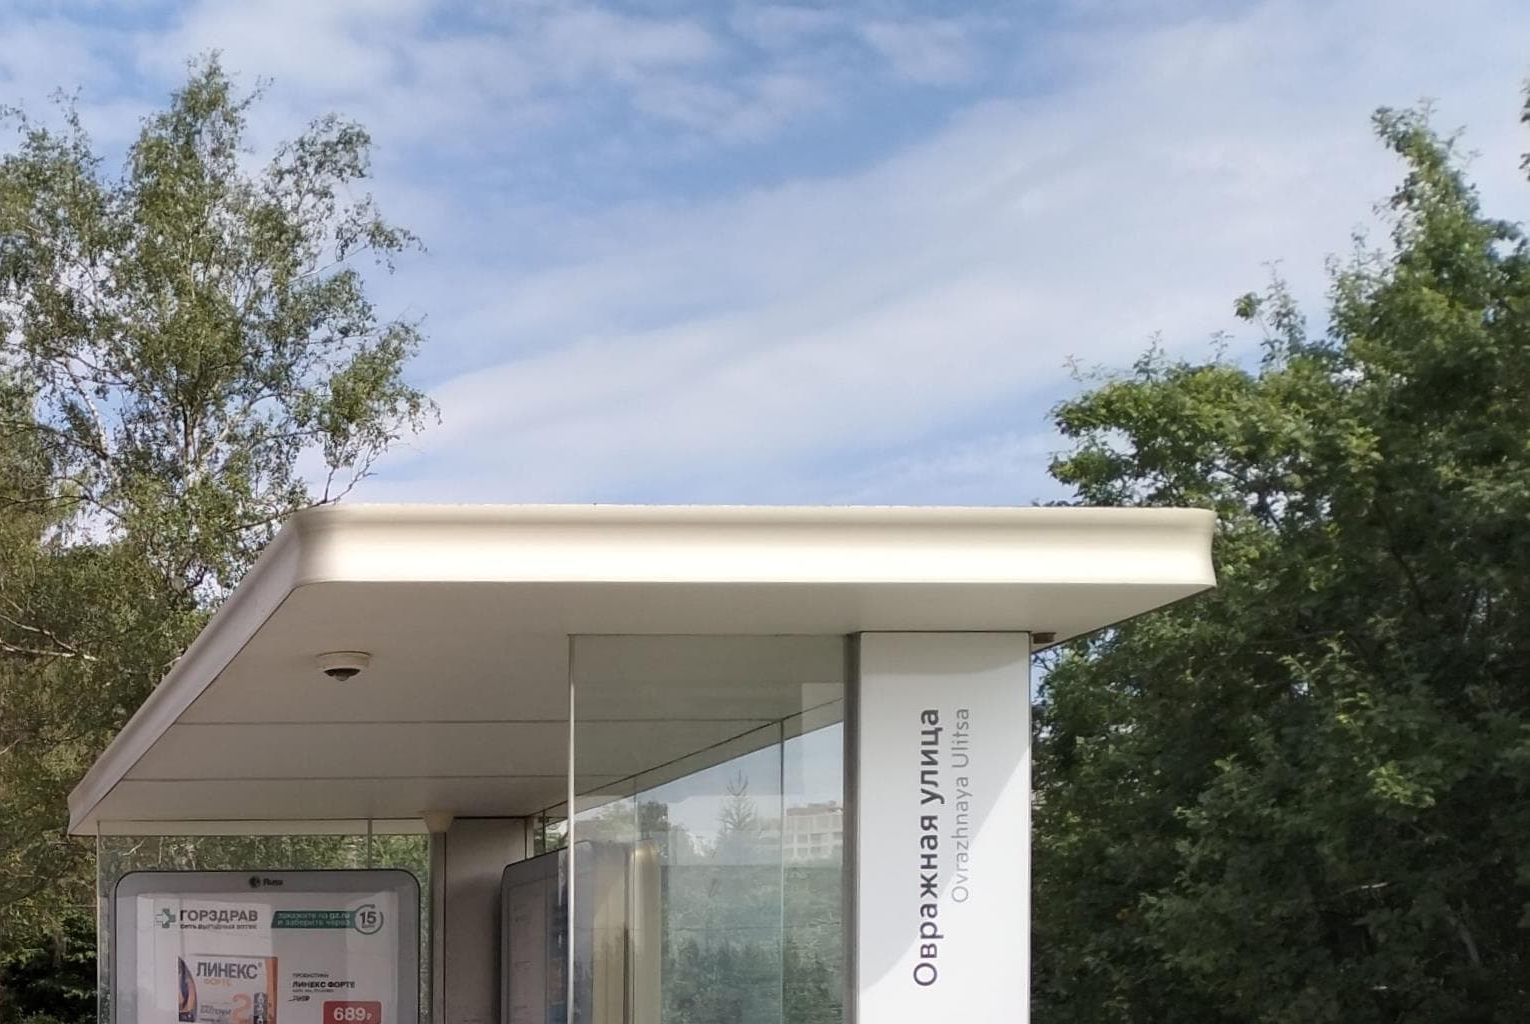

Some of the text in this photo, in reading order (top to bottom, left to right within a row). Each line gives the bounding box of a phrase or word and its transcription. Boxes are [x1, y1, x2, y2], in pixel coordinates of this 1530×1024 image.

[951, 708, 973, 903] Ovrazhnaya Ulitsa
[913, 708, 945, 987] Овражная улица
[180, 910, 258, 923] ГОРЗДРАВ
[359, 911, 377, 925] 15
[197, 961, 258, 979] ЛИНЕКС
